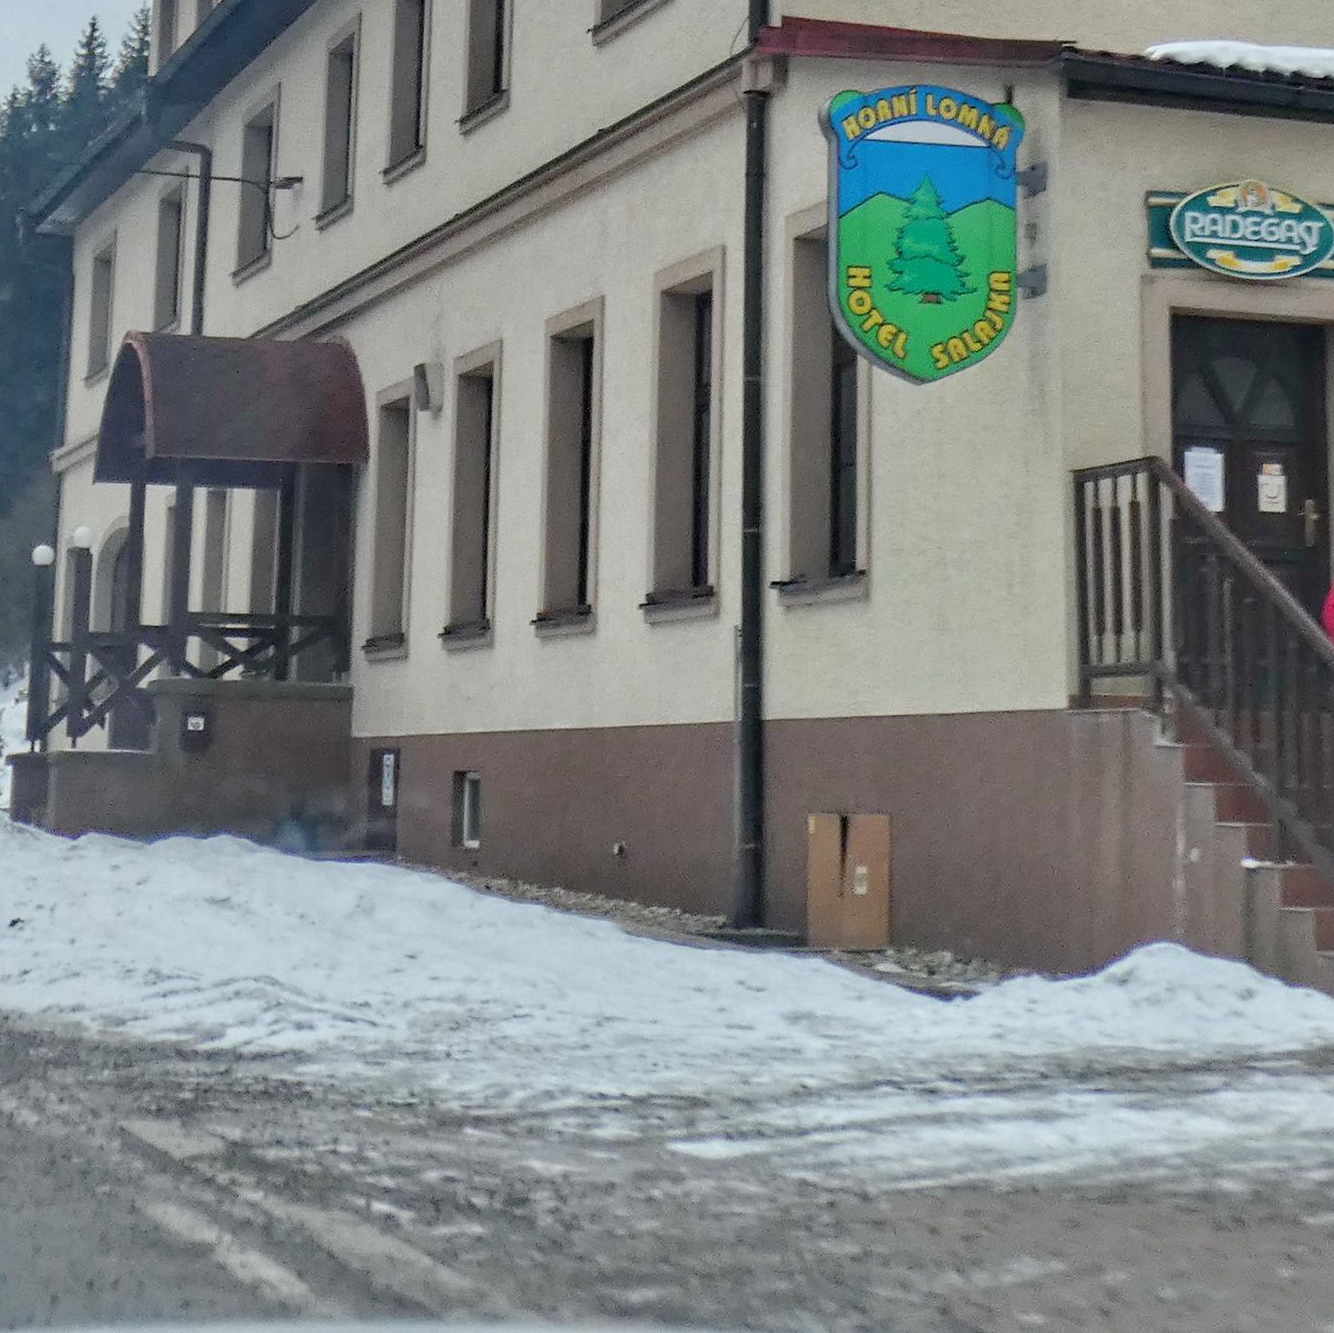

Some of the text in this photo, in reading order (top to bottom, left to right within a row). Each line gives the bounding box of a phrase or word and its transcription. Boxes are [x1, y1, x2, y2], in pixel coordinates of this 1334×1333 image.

[1184, 211, 1324, 255] RADEGAST
[847, 265, 1012, 369] HOTEL SALAJKA
